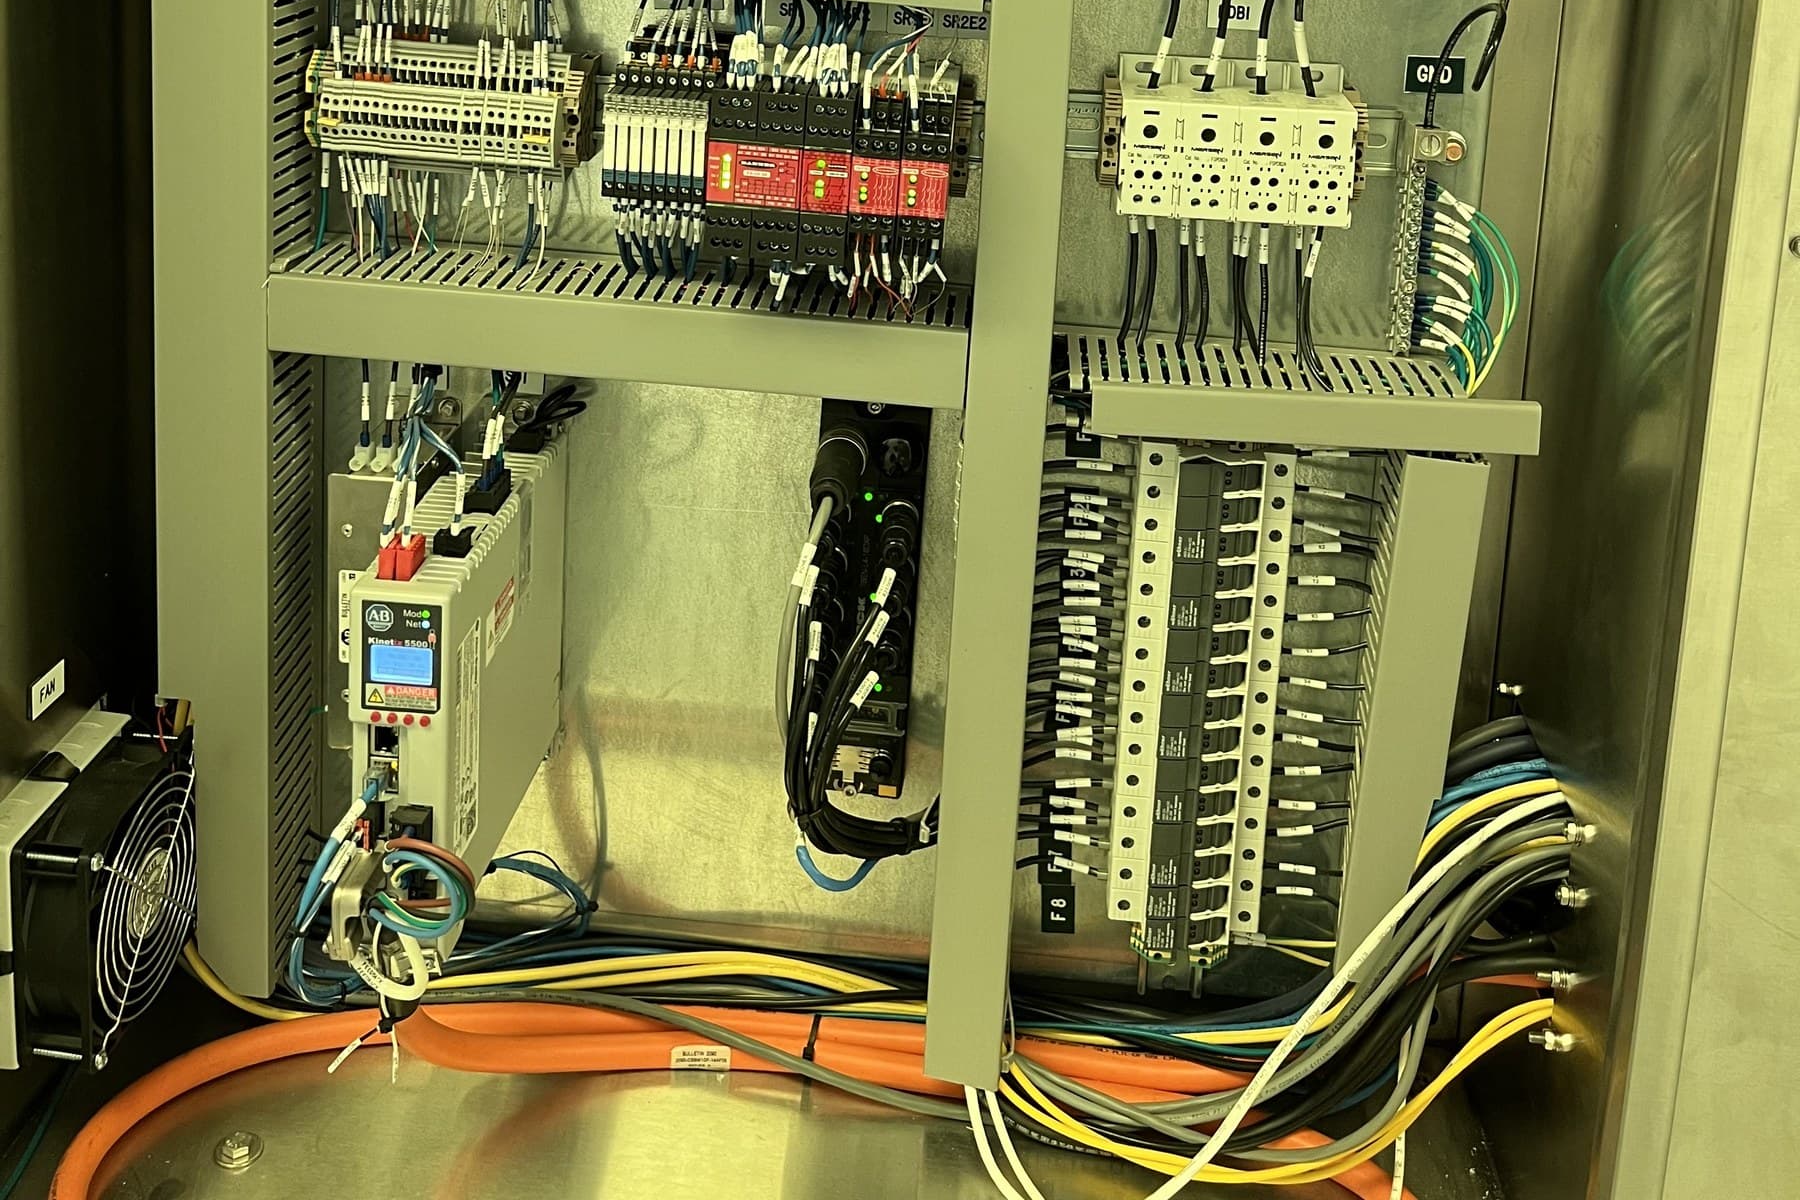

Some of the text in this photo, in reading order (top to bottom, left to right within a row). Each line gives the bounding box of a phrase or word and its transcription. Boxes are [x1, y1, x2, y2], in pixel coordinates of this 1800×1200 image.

[942, 14, 988, 31] SR2E2
[367, 636, 429, 648] Kinetix 5500
[40, 677, 56, 704] FAN
[396, 687, 435, 697] DANGER
